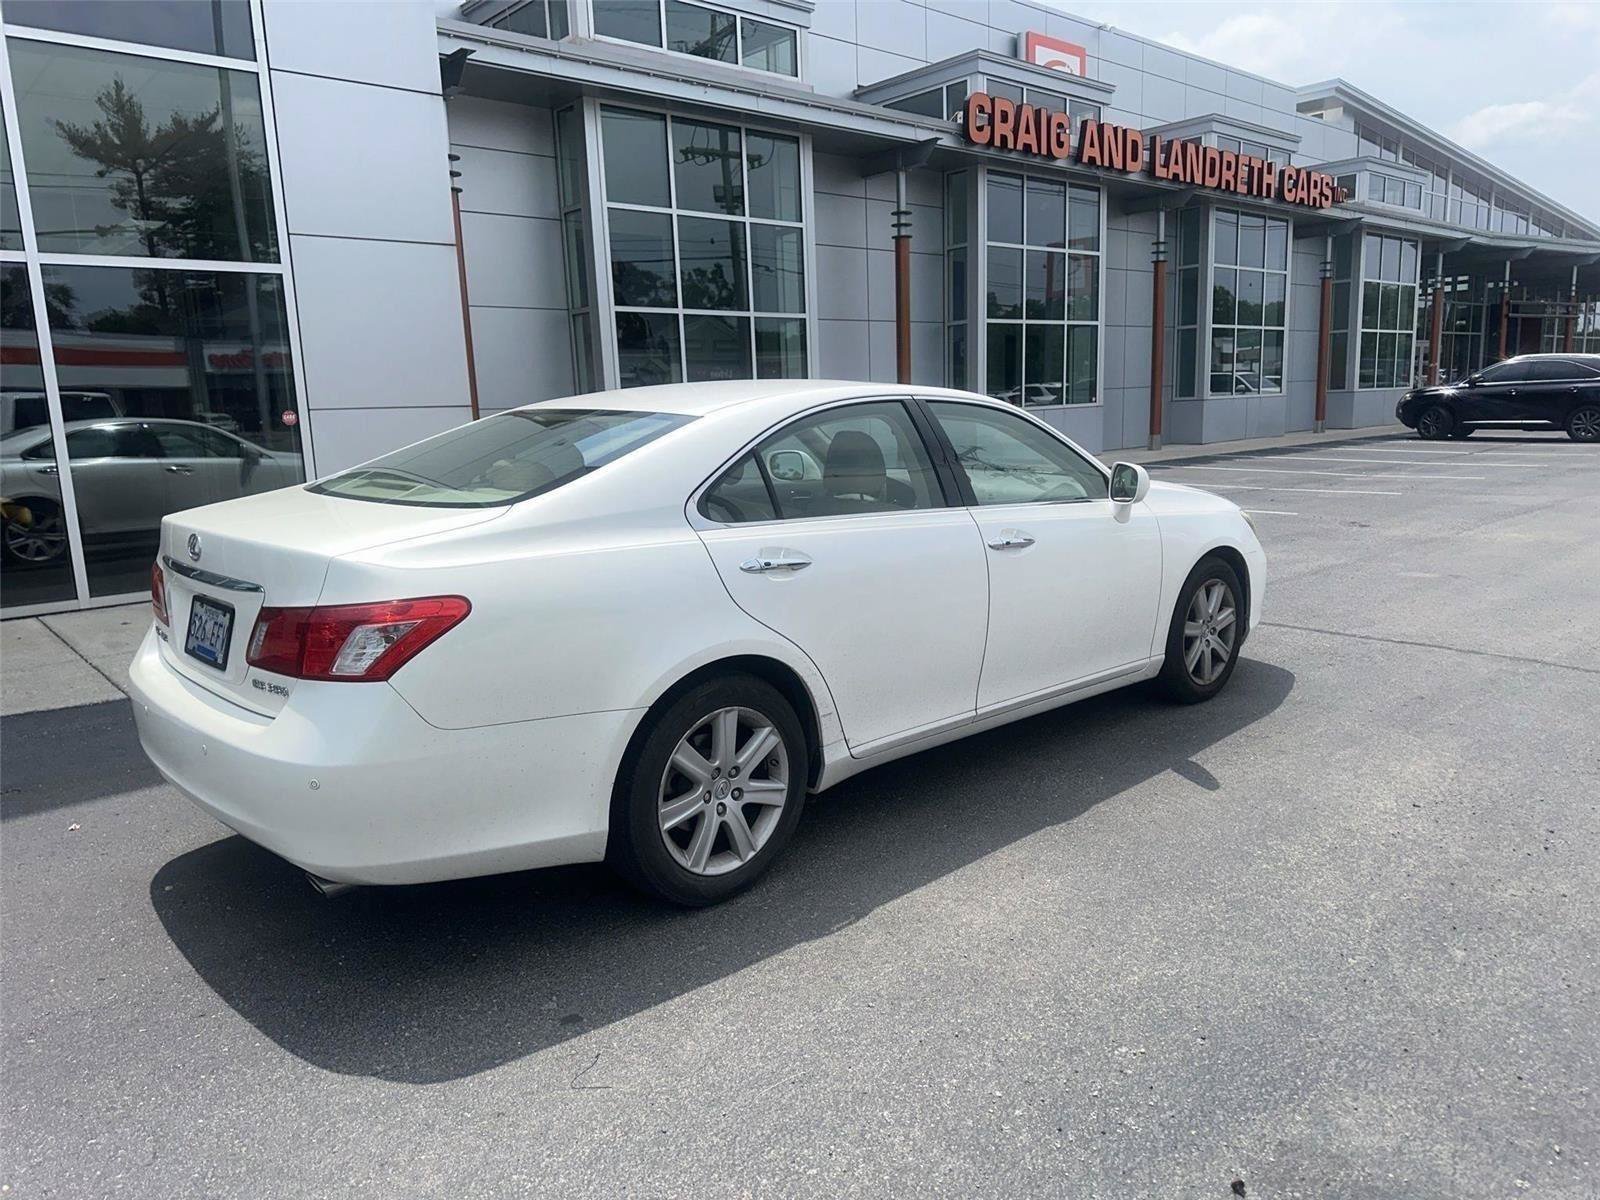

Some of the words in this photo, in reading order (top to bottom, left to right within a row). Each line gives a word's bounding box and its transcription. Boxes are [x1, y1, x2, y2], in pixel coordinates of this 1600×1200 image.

[966, 91, 1071, 160] CRAIG
[1080, 118, 1144, 173] AND
[1153, 135, 1277, 199] LANDRETH
[1282, 164, 1333, 209] CARS
